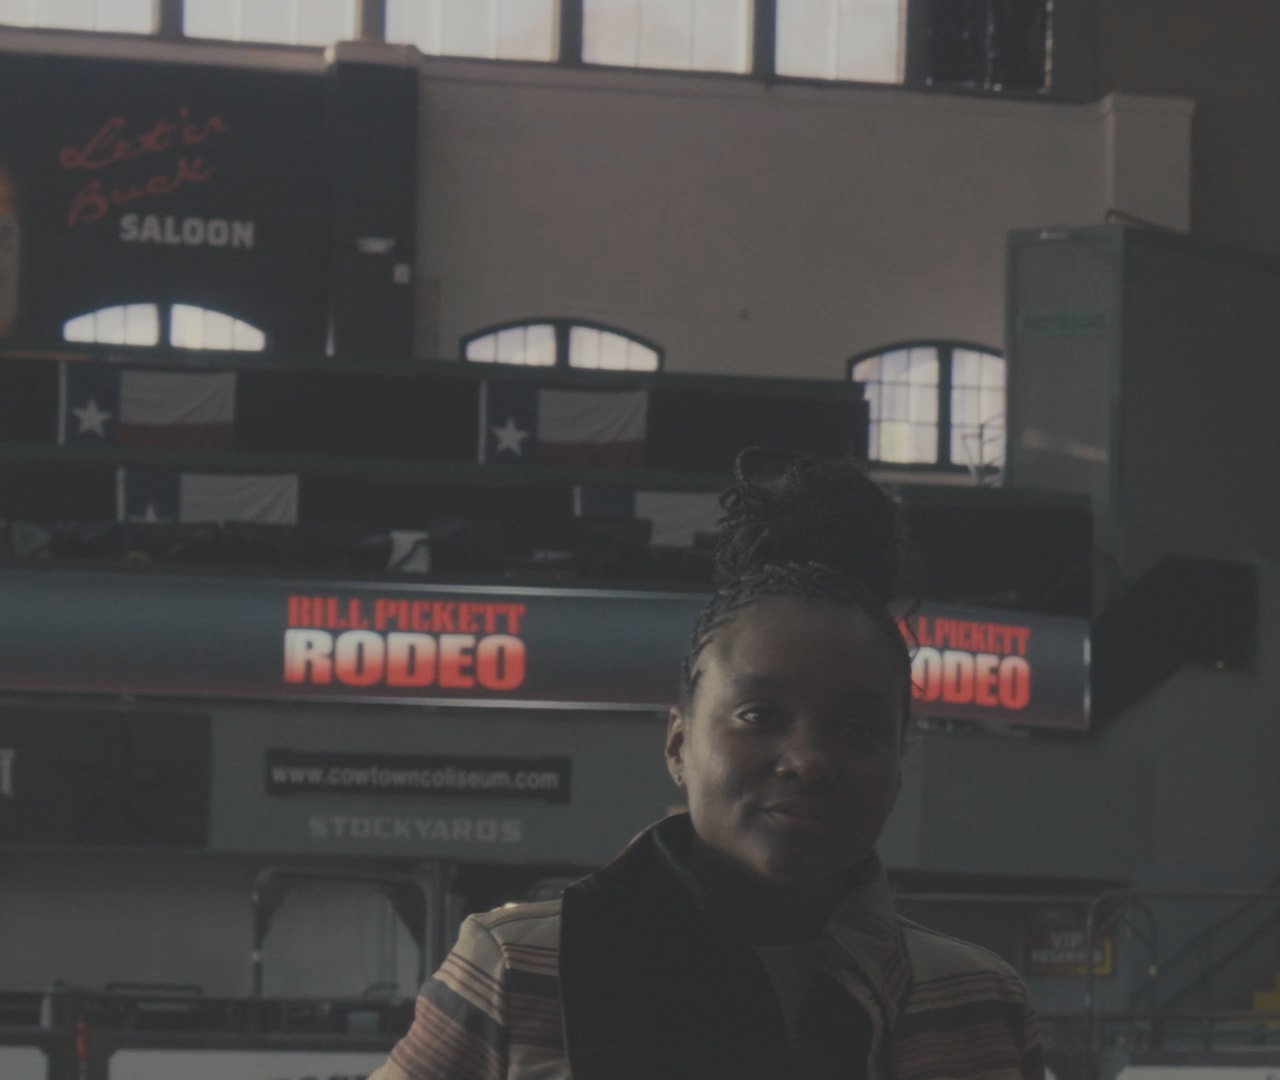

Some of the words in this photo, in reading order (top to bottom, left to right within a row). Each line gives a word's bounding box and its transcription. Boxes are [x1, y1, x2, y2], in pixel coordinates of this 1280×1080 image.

[66, 157, 216, 228] Buck
[120, 213, 255, 249] SALOON
[287, 595, 369, 629] BILL
[374, 598, 526, 636] PICKETT
[934, 617, 1031, 656] PICKETT
[284, 628, 526, 690] RODEO
[909, 646, 1031, 710] ODEO
[271, 765, 559, 789] www.cowtowncoliseum.com
[308, 814, 521, 843] STOCKYARDS
